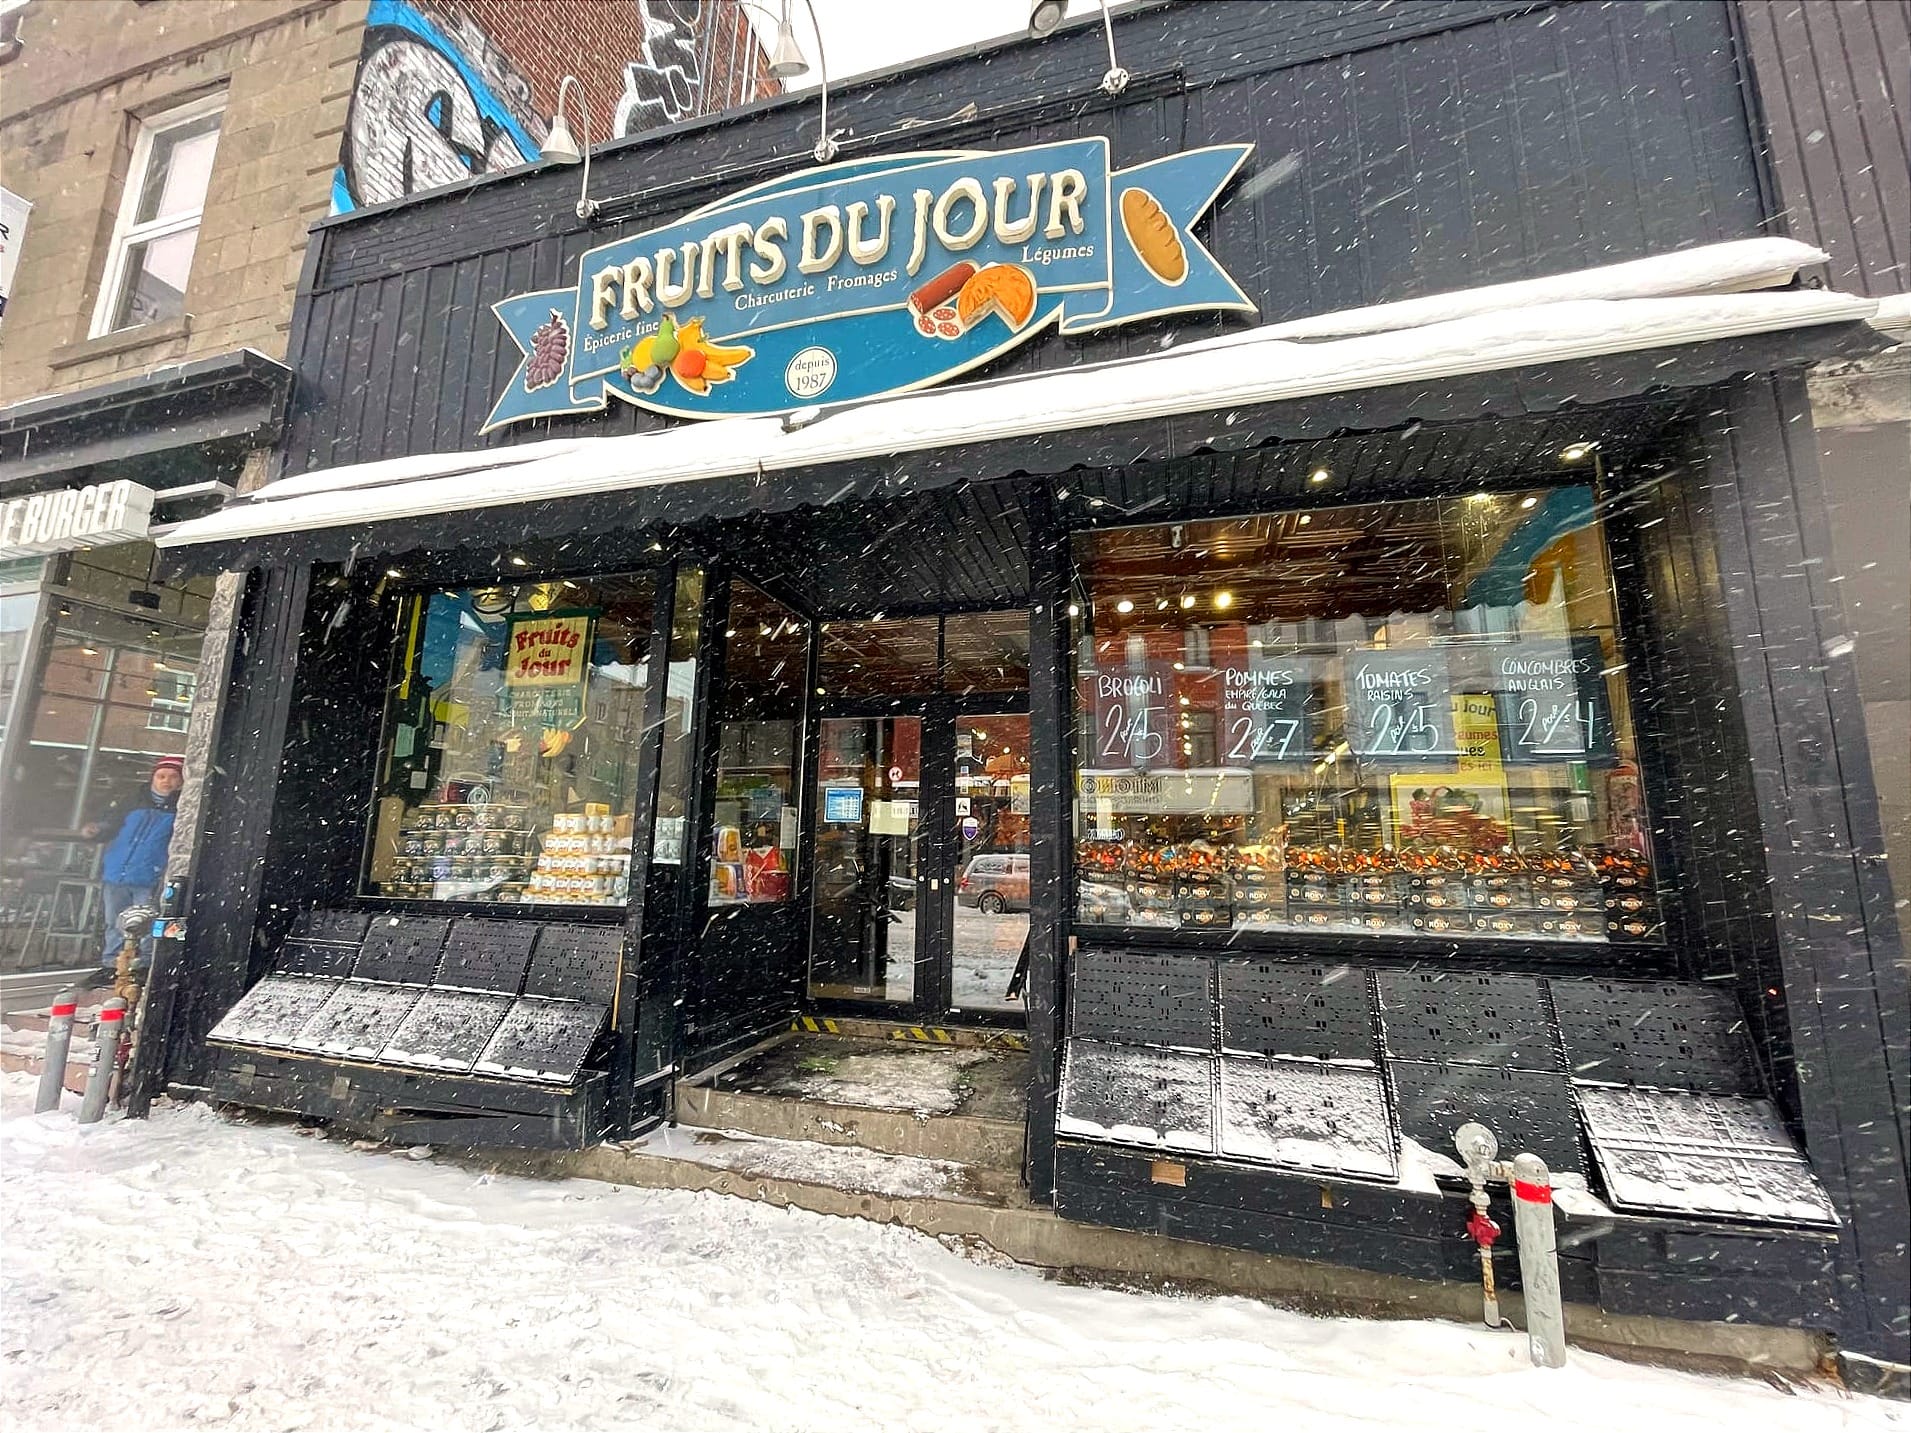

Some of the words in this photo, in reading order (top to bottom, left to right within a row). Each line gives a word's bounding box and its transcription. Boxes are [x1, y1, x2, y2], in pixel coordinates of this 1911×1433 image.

[589, 216, 788, 331] FRUITS
[797, 194, 896, 274] DU
[906, 168, 1087, 277] JOUR
[1021, 244, 1095, 265] Légumes
[735, 281, 815, 311] Charcuterie
[826, 269, 898, 292] Fromages
[583, 326, 632, 354] Épicerie
[635, 321, 659, 336] fine
[795, 355, 830, 373] depuis
[797, 372, 827, 391] 1987
[0, 499, 24, 548] E
[19, 479, 132, 545] BURGER
[515, 622, 581, 653] Fruits
[538, 648, 551, 658] du
[515, 656, 571, 678] Jour
[1502, 657, 1591, 675] CONCOMBRES
[1098, 671, 1162, 698] BROCOLI
[1226, 668, 1293, 686] POMMES
[1356, 664, 1432, 689] TOMATES
[1509, 678, 1565, 691] ANGLAIS
[1368, 688, 1413, 701] RAISINS
[1225, 702, 1237, 710] du
[1459, 746, 1486, 757] ues
[1366, 893, 1386, 901] ROXY
[1556, 899, 1579, 907] ROXY
[1309, 915, 1328, 924] ROXY
[1366, 919, 1386, 928] ROXY
[1428, 921, 1450, 929] ROXY
[1492, 921, 1514, 930] ROXY
[1559, 923, 1581, 931] ROXY
